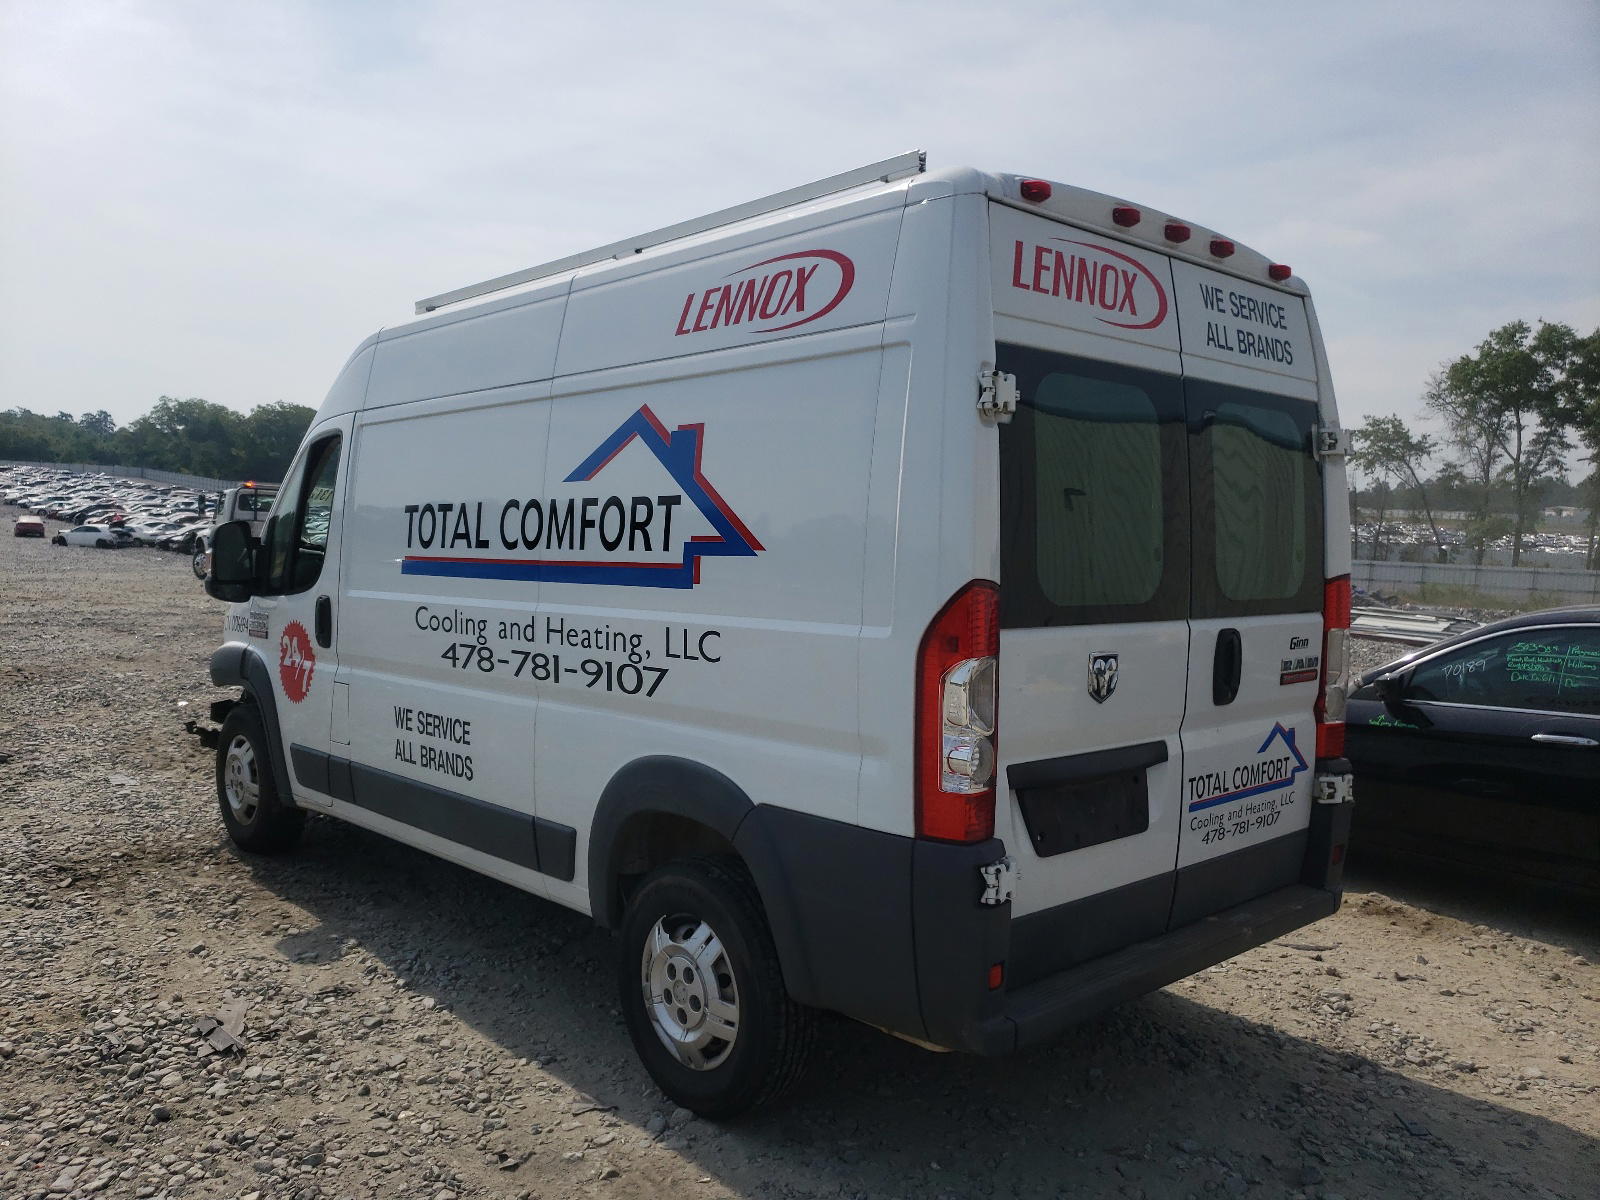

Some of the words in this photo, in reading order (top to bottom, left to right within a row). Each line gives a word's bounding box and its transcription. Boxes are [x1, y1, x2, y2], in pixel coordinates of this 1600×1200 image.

[675, 263, 820, 337] LENNOX
[1012, 240, 1138, 316] LENNOX
[1200, 282, 1226, 314] WE
[1230, 291, 1288, 331] SERVICE
[1206, 321, 1234, 352] ALL
[1237, 329, 1293, 366] BRANDS
[404, 501, 490, 550] TOTAL
[499, 495, 682, 552] COMFORT
[415, 605, 488, 645] Cooling
[498, 615, 536, 643] and
[546, 616, 651, 664] Heating,
[665, 626, 721, 663] LLC
[1289, 636, 1310, 650] Ginn
[282, 635, 312, 693] 24/7
[441, 642, 669, 698] 478-781-9107
[1280, 657, 1319, 672] RAM
[393, 705, 413, 732] WE
[416, 710, 471, 746] SERVICE
[394, 738, 417, 766] ALL
[420, 744, 474, 782] BRANDS
[1188, 770, 1230, 801] TOTAL
[1233, 756, 1290, 791] COMFORT
[1190, 813, 1225, 832] Cooling
[1227, 805, 1243, 822] and
[1245, 799, 1278, 816] Heating,
[1280, 791, 1296, 807] LLC
[1201, 810, 1281, 845] 478-781-9107
